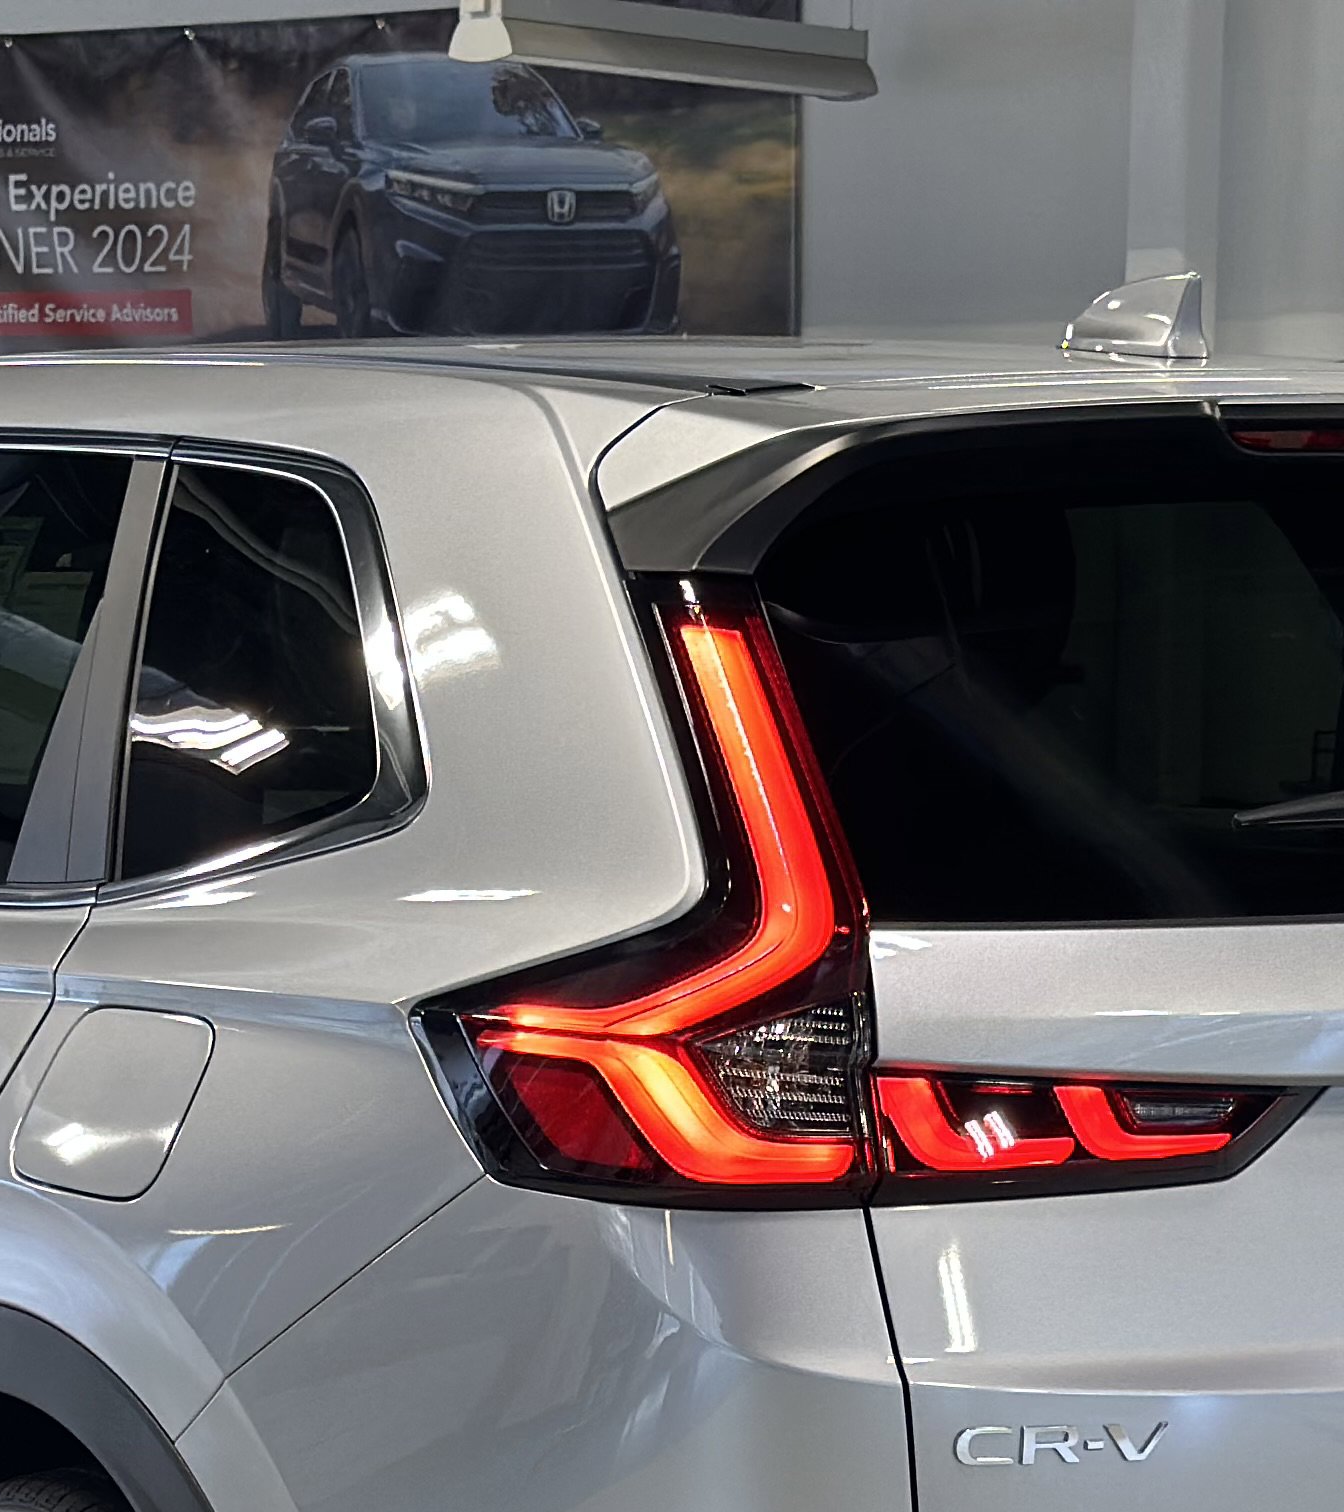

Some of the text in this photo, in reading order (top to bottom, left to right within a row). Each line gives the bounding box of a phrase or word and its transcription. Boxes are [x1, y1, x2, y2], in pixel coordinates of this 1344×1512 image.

[8, 171, 196, 222] Experience
[91, 223, 194, 275] 2024
[44, 303, 107, 323] Service
[111, 302, 179, 322] Advisors
[954, 1420, 1169, 1466] CR-V
